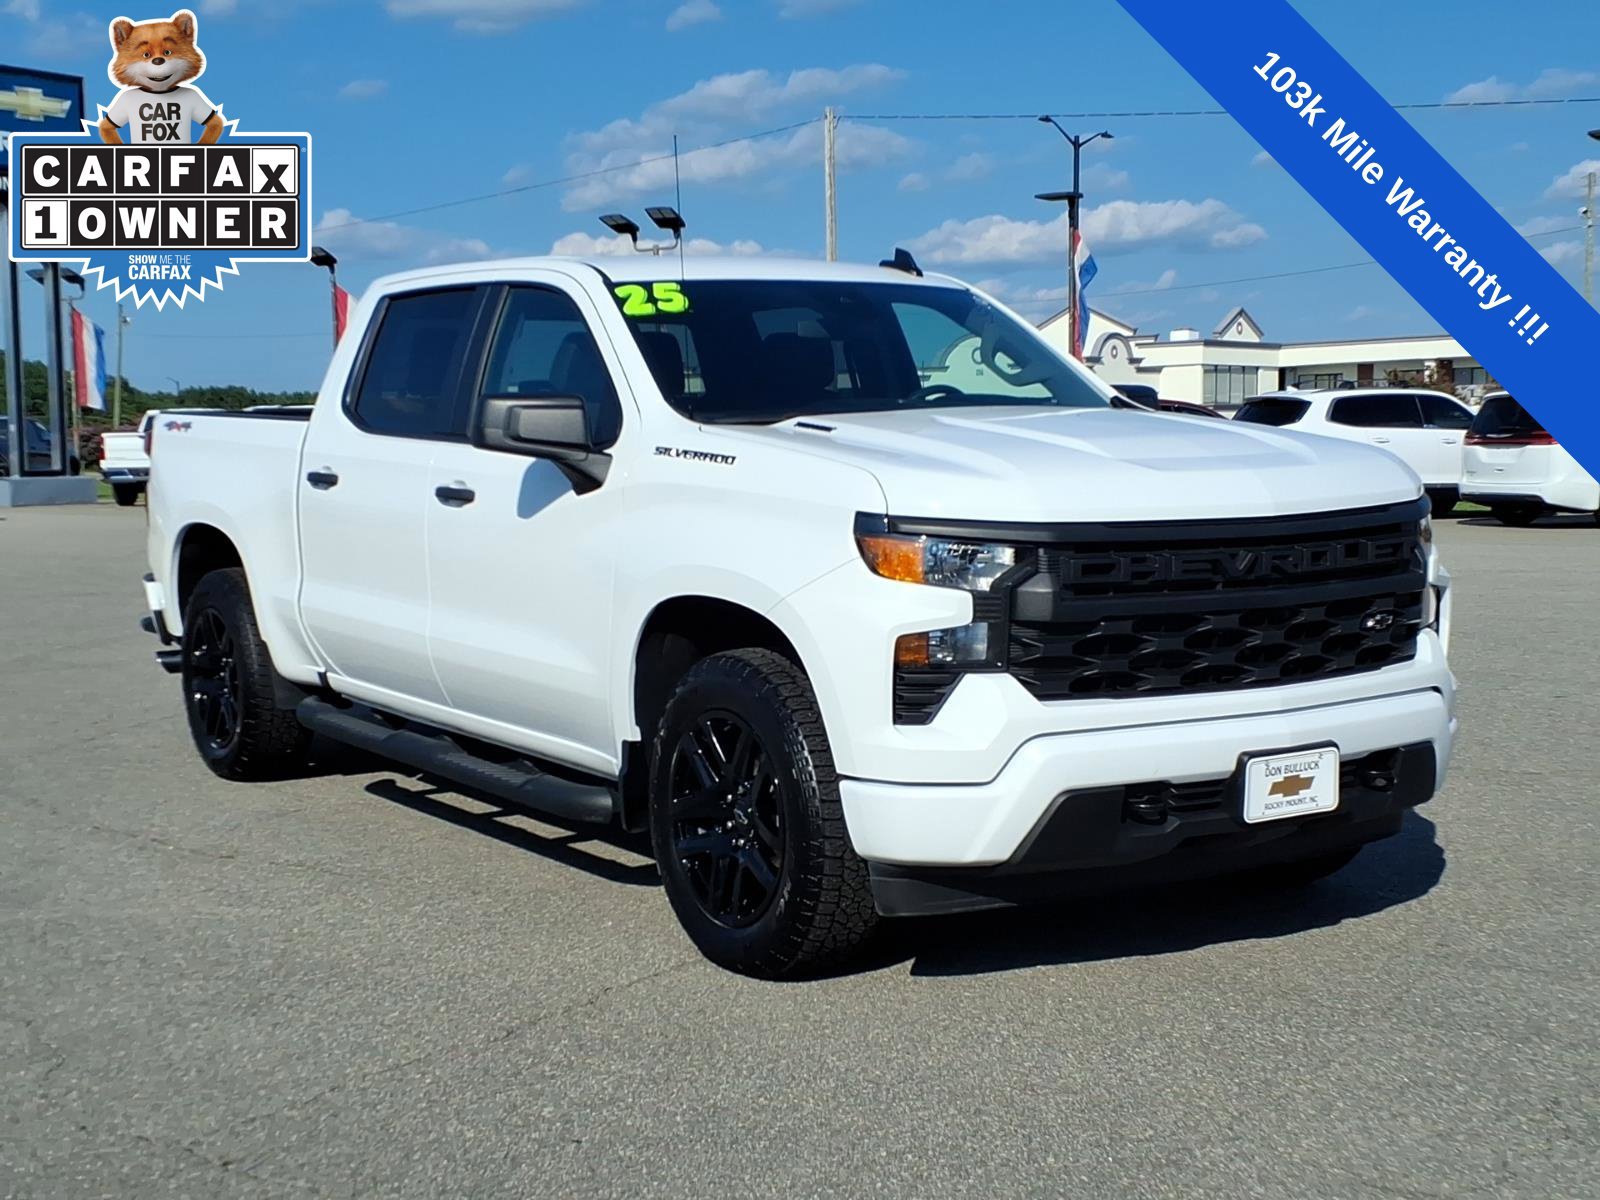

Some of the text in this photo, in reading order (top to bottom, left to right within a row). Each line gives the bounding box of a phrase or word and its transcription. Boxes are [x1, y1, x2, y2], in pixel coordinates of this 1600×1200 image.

[614, 282, 689, 316] 25
[654, 446, 737, 465] SILVERADO
[1265, 761, 1320, 777] DON BULLUCK
